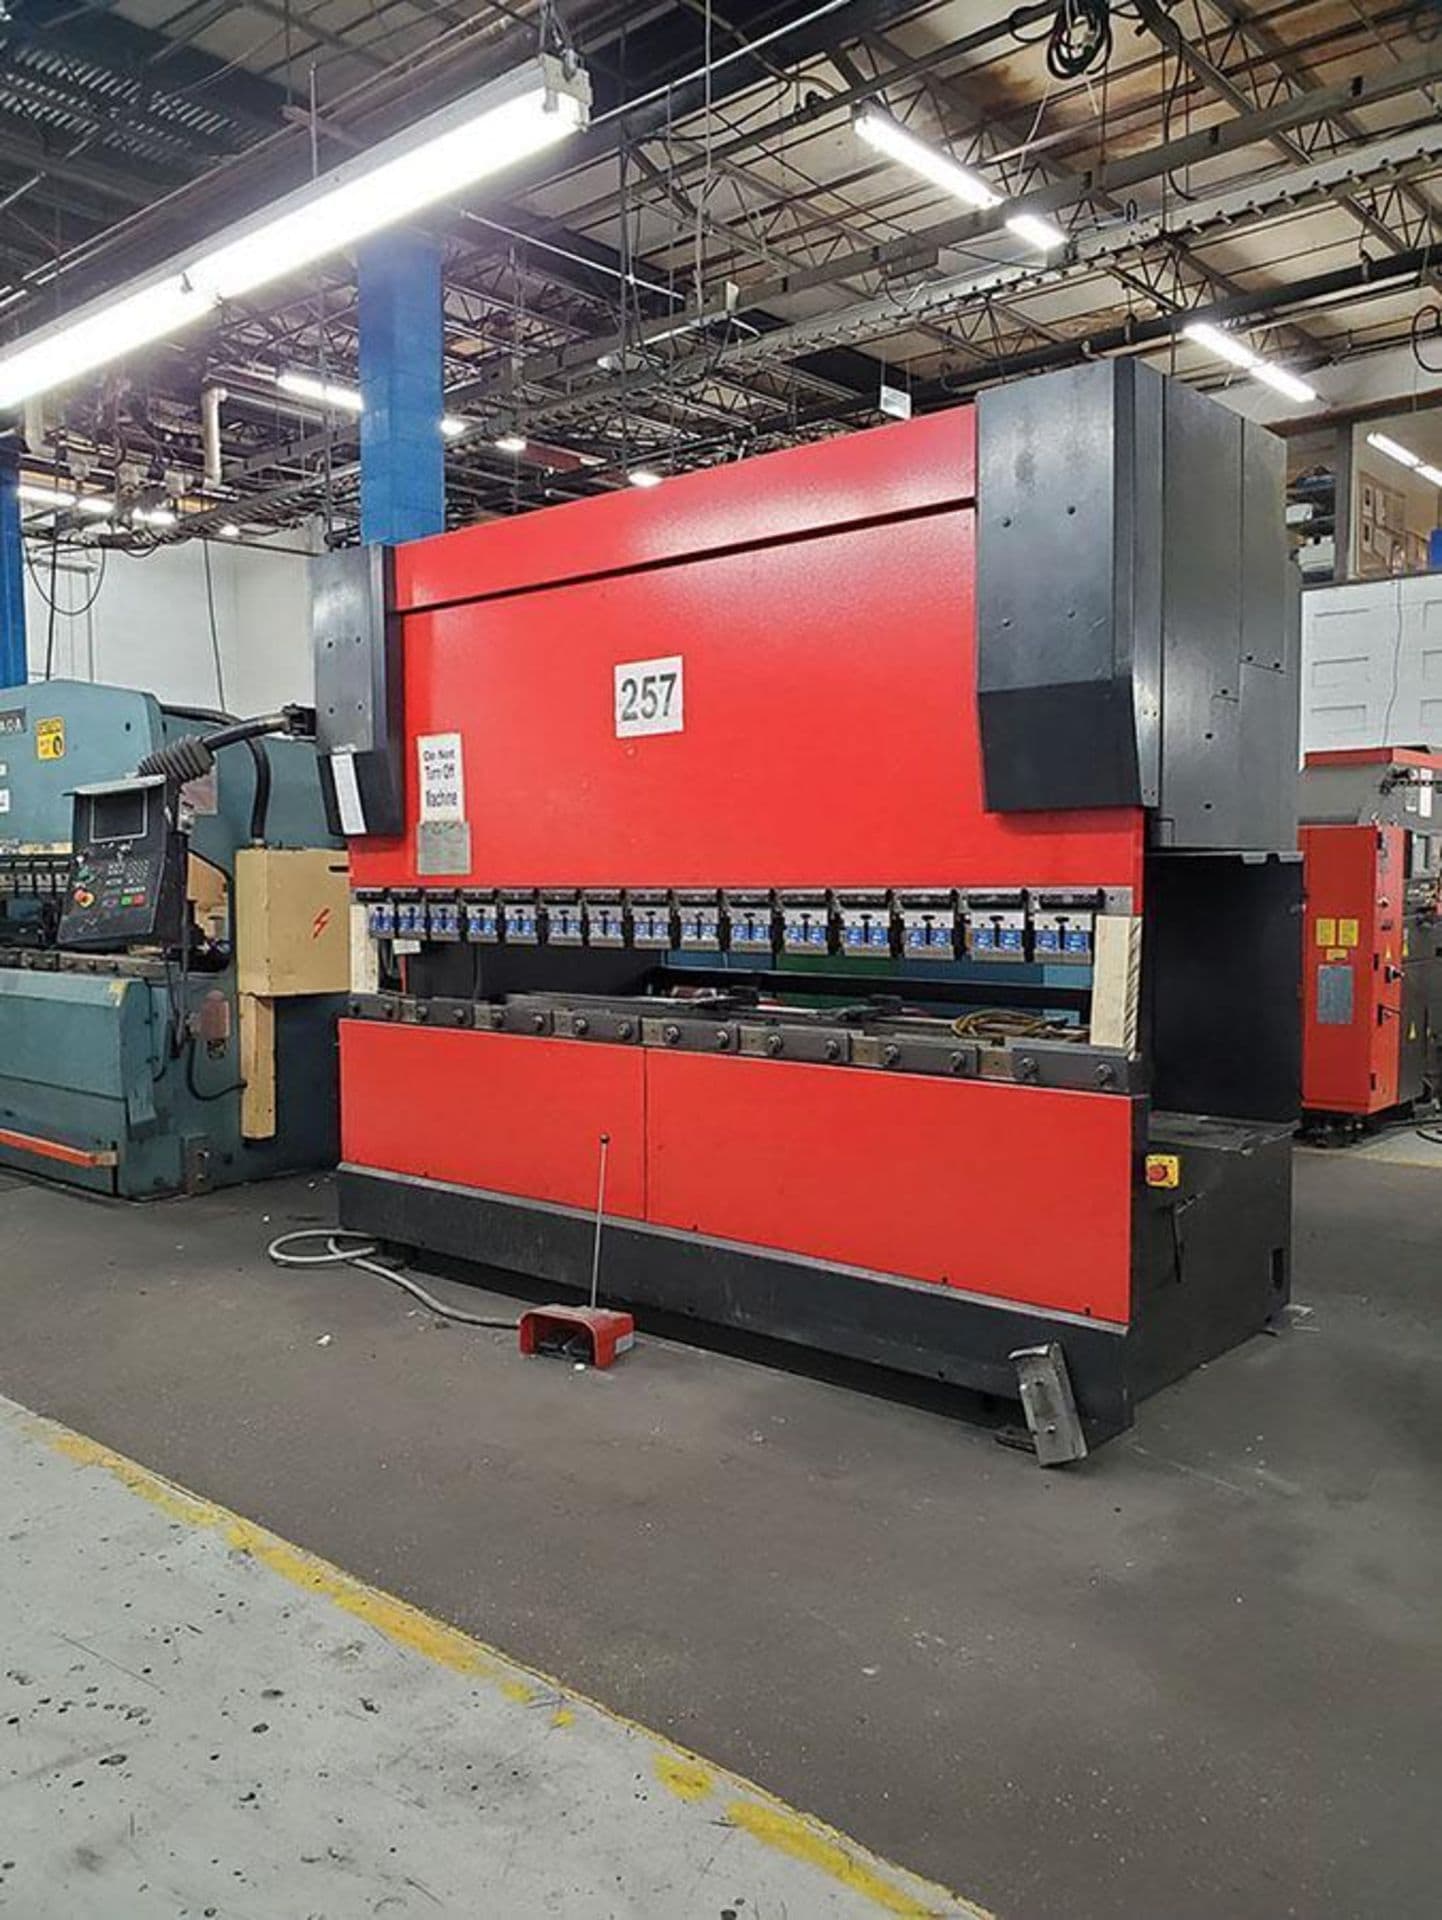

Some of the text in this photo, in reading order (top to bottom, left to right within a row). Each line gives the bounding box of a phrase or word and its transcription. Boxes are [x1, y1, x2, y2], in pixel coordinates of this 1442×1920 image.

[622, 672, 677, 721] 257
[423, 748, 455, 762] Do Not
[426, 789, 458, 808] Machine
